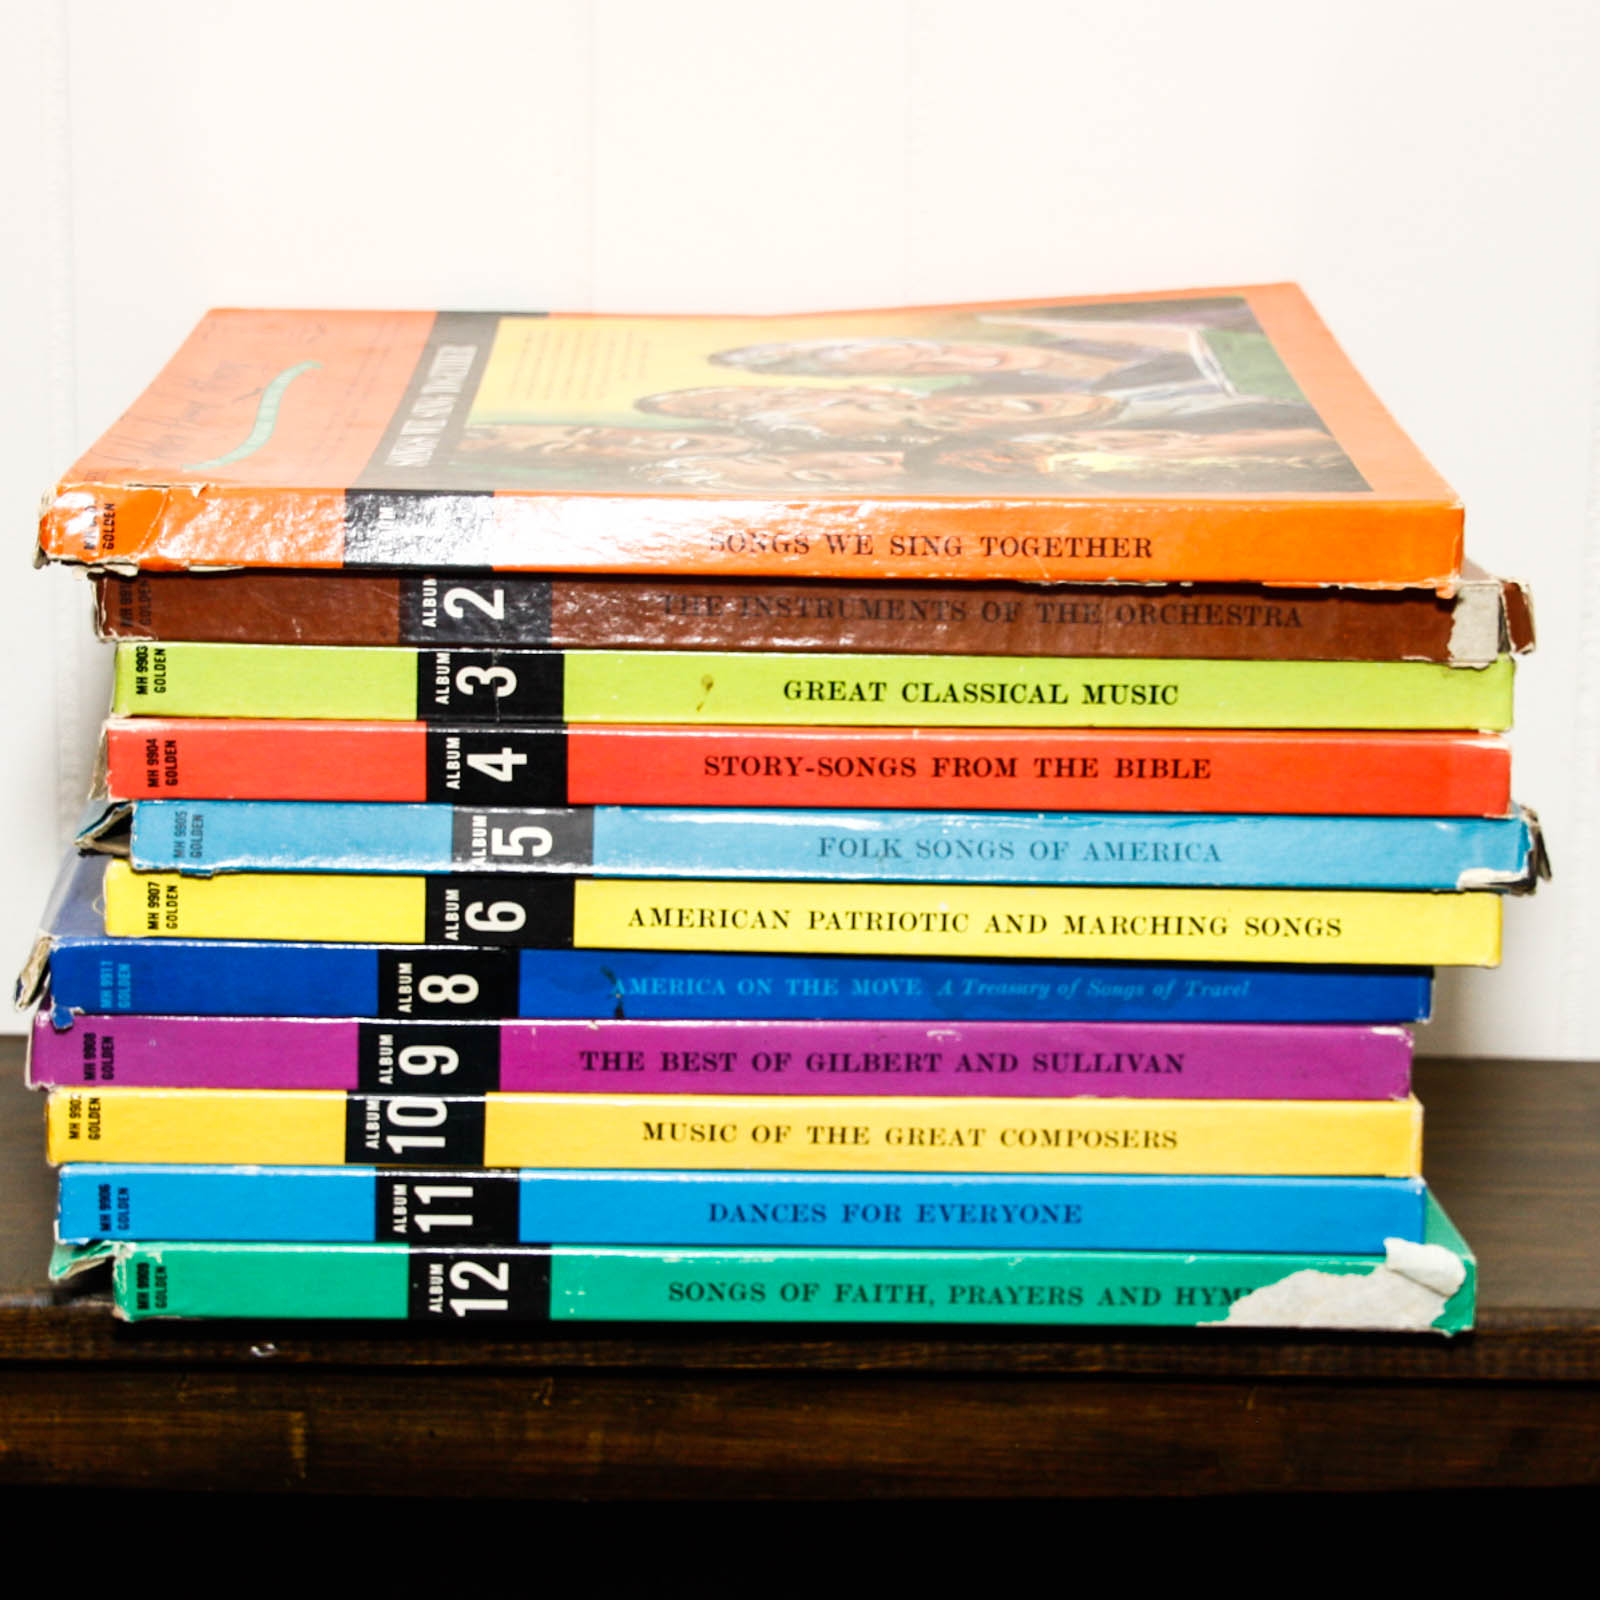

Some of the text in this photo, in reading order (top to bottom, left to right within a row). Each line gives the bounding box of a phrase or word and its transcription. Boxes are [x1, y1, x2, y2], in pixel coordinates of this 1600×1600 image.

[103, 503, 115, 549] GOLDEN
[710, 532, 1152, 559] SONGS WE SING TOGETHER
[443, 587, 504, 620] 2
[663, 594, 1303, 628] THE INSTRUMENTS OF THE ORCHESTRA
[136, 645, 148, 695] MH 9903
[154, 648, 166, 693] GOLDEN
[435, 652, 450, 705] ALBUM
[456, 666, 517, 697] 3
[783, 681, 1177, 705] GREAT CLASSICAL MUSIC
[146, 738, 159, 787] MH 9904
[165, 740, 178, 786] GOLDEN
[446, 737, 460, 790] ALBUM
[467, 747, 527, 782] 4
[705, 756, 1210, 779] STORY-SONGS FROM THE BIBLE
[174, 841, 185, 858] MH
[190, 814, 203, 858] GOLDEN
[472, 815, 487, 867] ALBUM
[491, 826, 553, 857] 5
[820, 837, 1222, 862] FOLK SONGS OF AMERICA
[148, 882, 160, 930] MH 9907
[166, 885, 178, 929] GOLDEN
[445, 889, 460, 941] ALBUM
[465, 901, 526, 932] 6
[628, 908, 1342, 938] AMERICAN PATRIOTIC AND MARCHING SONGS
[118, 963, 131, 1008] GOLDEN
[398, 963, 412, 1013] ALBUM
[418, 974, 479, 1004] 8
[611, 977, 1251, 1001] AMERICA ON THE MOVE A Treasury of Songs of Travel
[84, 1063, 96, 1080] MH
[102, 1036, 114, 1080] GOLDEN
[379, 1034, 393, 1084] ALBUM
[398, 1045, 459, 1075] 9
[580, 1051, 1186, 1074] THE BEST OF GILBERT AND SULLIVAN
[69, 1123, 80, 1139] MH
[88, 1097, 101, 1140] GOLDEN
[365, 1096, 380, 1149] ALBUM
[386, 1096, 447, 1154] 10
[643, 1122, 1177, 1149] MUSIC OF THE GREAT COMPOSERS
[99, 1214, 111, 1231] MH
[117, 1186, 129, 1230] GOLDEN
[393, 1184, 407, 1233] ALBUM
[414, 1185, 473, 1233] 11
[709, 1204, 1082, 1225] DANCES FOR EVERYONE
[155, 1266, 167, 1308] GOLDEN
[429, 1263, 443, 1313] ALBUM
[450, 1261, 509, 1317] 12
[669, 1282, 1252, 1309] SONGS OF FAITH, PRAYERS AND HYM
